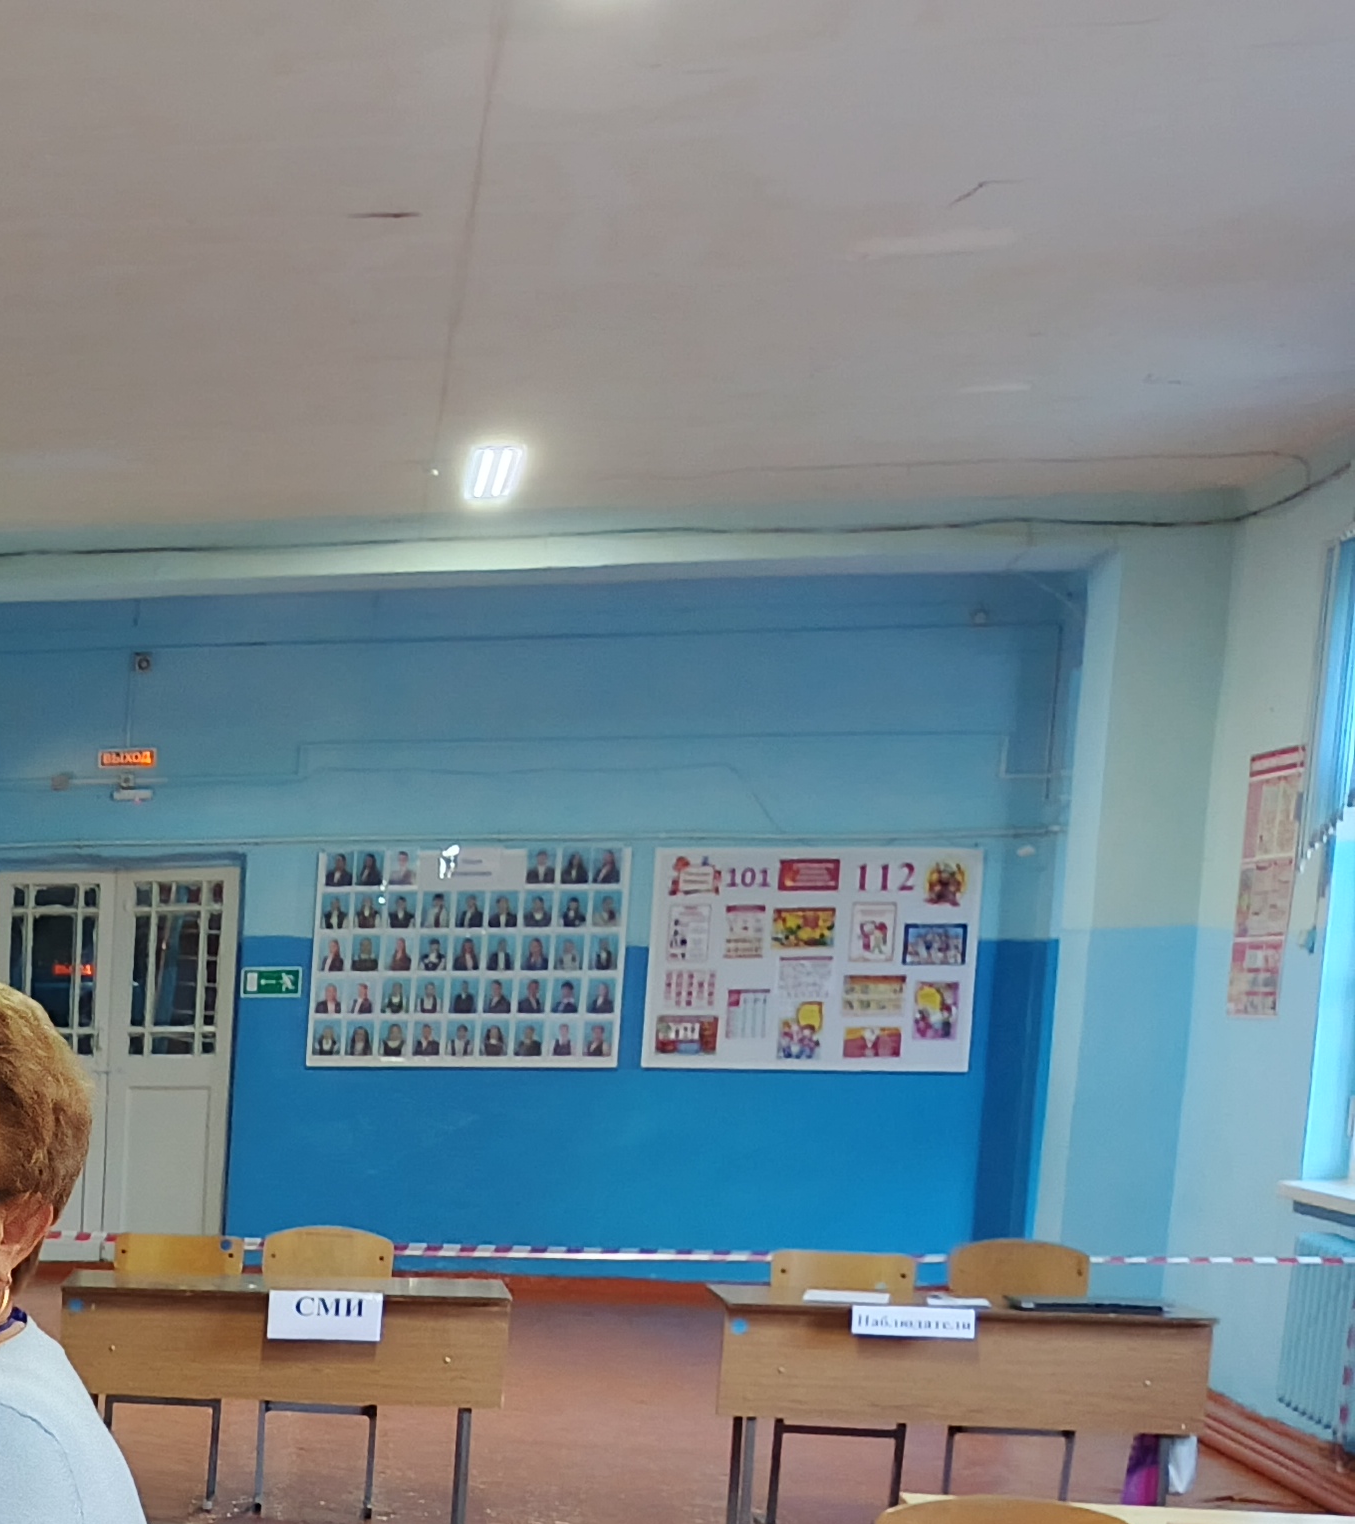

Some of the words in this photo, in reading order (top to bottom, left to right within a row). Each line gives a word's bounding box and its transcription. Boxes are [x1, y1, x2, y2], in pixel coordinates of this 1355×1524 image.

[103, 751, 151, 764] ВЫХОД
[726, 867, 771, 887] 101
[295, 1296, 363, 1317] СМИ
